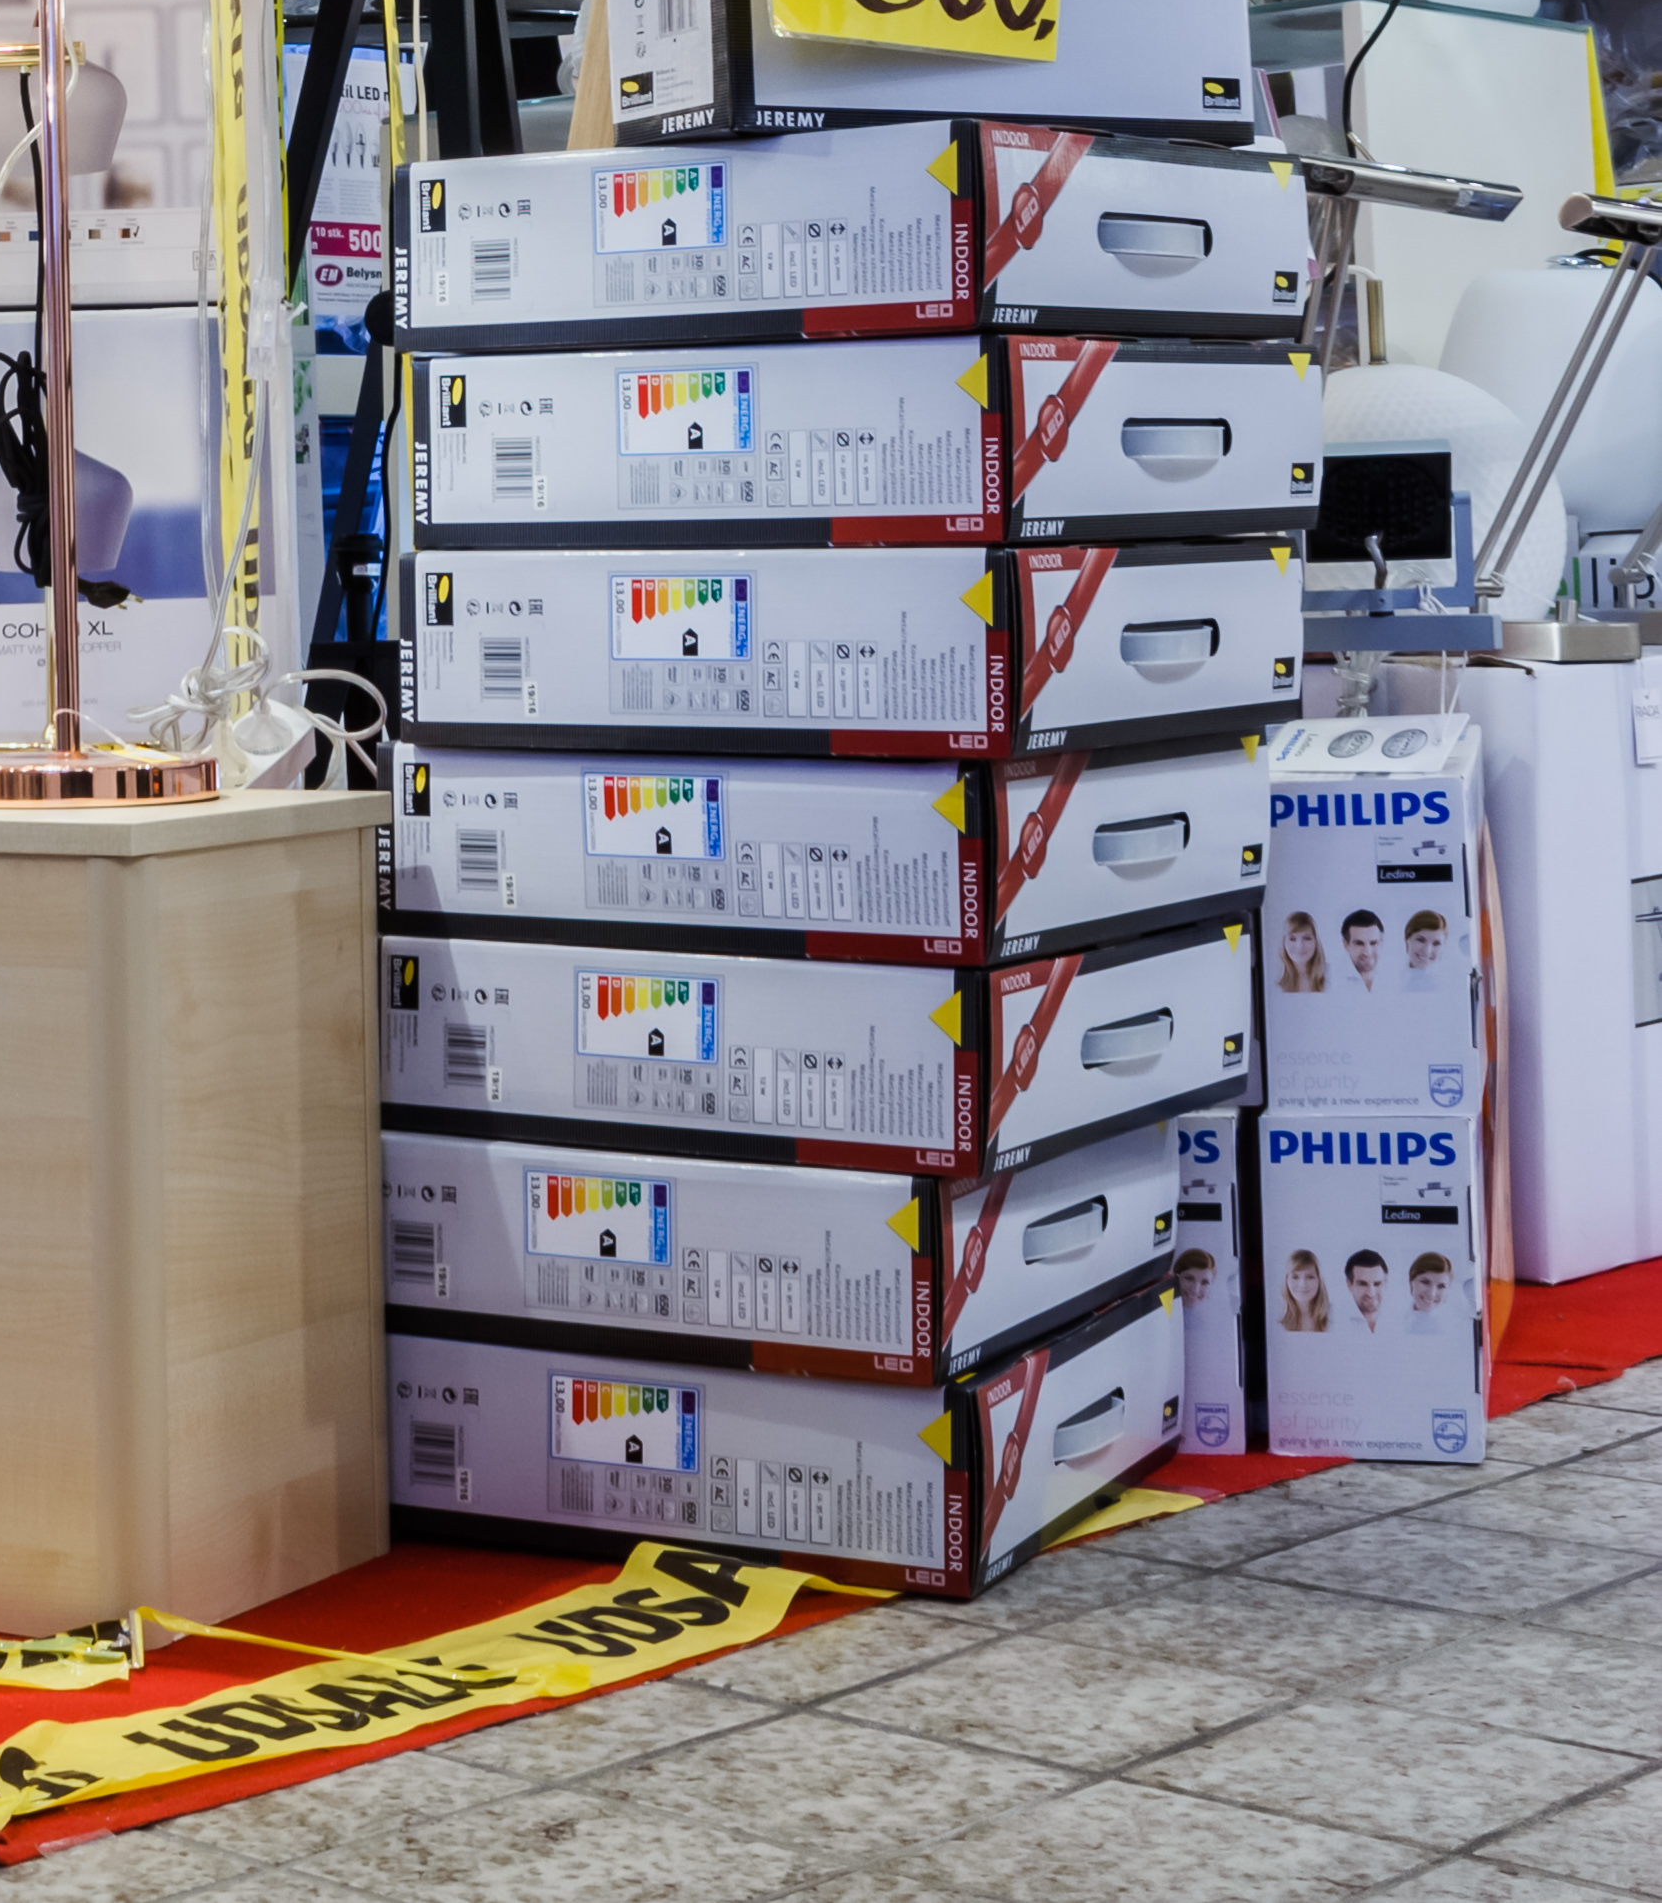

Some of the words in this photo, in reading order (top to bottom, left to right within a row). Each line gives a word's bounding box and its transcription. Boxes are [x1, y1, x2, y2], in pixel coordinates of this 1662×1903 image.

[357, 87, 380, 101] LED
[1203, 94, 1240, 108] Brilliant
[661, 109, 715, 134] JEREMY
[755, 110, 825, 128] JEREMY
[992, 130, 1030, 147] INDOOR
[598, 176, 608, 208] 13,00
[421, 182, 431, 231] Brilliant
[316, 227, 326, 237] 10
[954, 223, 969, 301] INDOOR
[395, 247, 408, 329] JEREMY
[439, 274, 447, 304] 19/16
[916, 303, 954, 319] LED
[993, 307, 1038, 324] JEREMY
[1019, 344, 1056, 358] INDOOR
[441, 378, 451, 426] Brilliant
[622, 377, 633, 410] 13,00
[415, 442, 429, 525] JEREMY
[984, 437, 1000, 515] INDOOR
[537, 479, 545, 508] 19/16
[946, 516, 985, 533] LED
[1021, 520, 1064, 536] JEREMY
[1030, 554, 1064, 569] INDOOR
[427, 575, 438, 624] Brilliant
[614, 581, 625, 614] 13,00
[87, 620, 113, 636] XL
[400, 638, 415, 723] JEREMY
[527, 684, 536, 714] 19/16
[989, 654, 1005, 734] INDOOR
[949, 732, 989, 751] LED
[1028, 730, 1067, 749] JEREMY
[405, 765, 415, 814] Brilliant
[588, 777, 599, 810] 13,00
[1270, 790, 1450, 828] PHILIPS
[378, 827, 391, 910] JEREMY
[1380, 868, 1416, 881] Ledino
[962, 861, 979, 940] INDOOR
[923, 937, 963, 957] LED
[1001, 935, 1041, 957] JEREMY
[581, 976, 592, 1009] 13,00
[1277, 1049, 1352, 1066] essence
[1277, 1070, 1297, 1089] of
[1301, 1072, 1361, 1095] purity
[956, 1074, 973, 1154] INDOOR
[1277, 1096, 1306, 1108] giving
[1308, 1095, 1328, 1107] light
[1339, 1097, 1362, 1105] new
[1363, 1096, 1420, 1108] experience
[916, 1148, 956, 1170] LED
[1269, 1130, 1457, 1166] PHILIPS
[994, 1148, 1032, 1175] JEREMY
[1384, 1209, 1421, 1221] Ledino
[914, 1280, 931, 1360] INDOOR
[874, 1353, 914, 1375] LED
[949, 1346, 982, 1375] JEREMY
[1278, 1392, 1355, 1406] essence
[1305, 1414, 1363, 1432] purity
[1278, 1437, 1307, 1450] giving
[1309, 1437, 1330, 1449] light
[1342, 1440, 1363, 1448] new
[1366, 1440, 1422, 1450] experience
[947, 1494, 963, 1574] INDOOR
[906, 1566, 947, 1589] LED
[510, 1548, 750, 1658] UDSA
